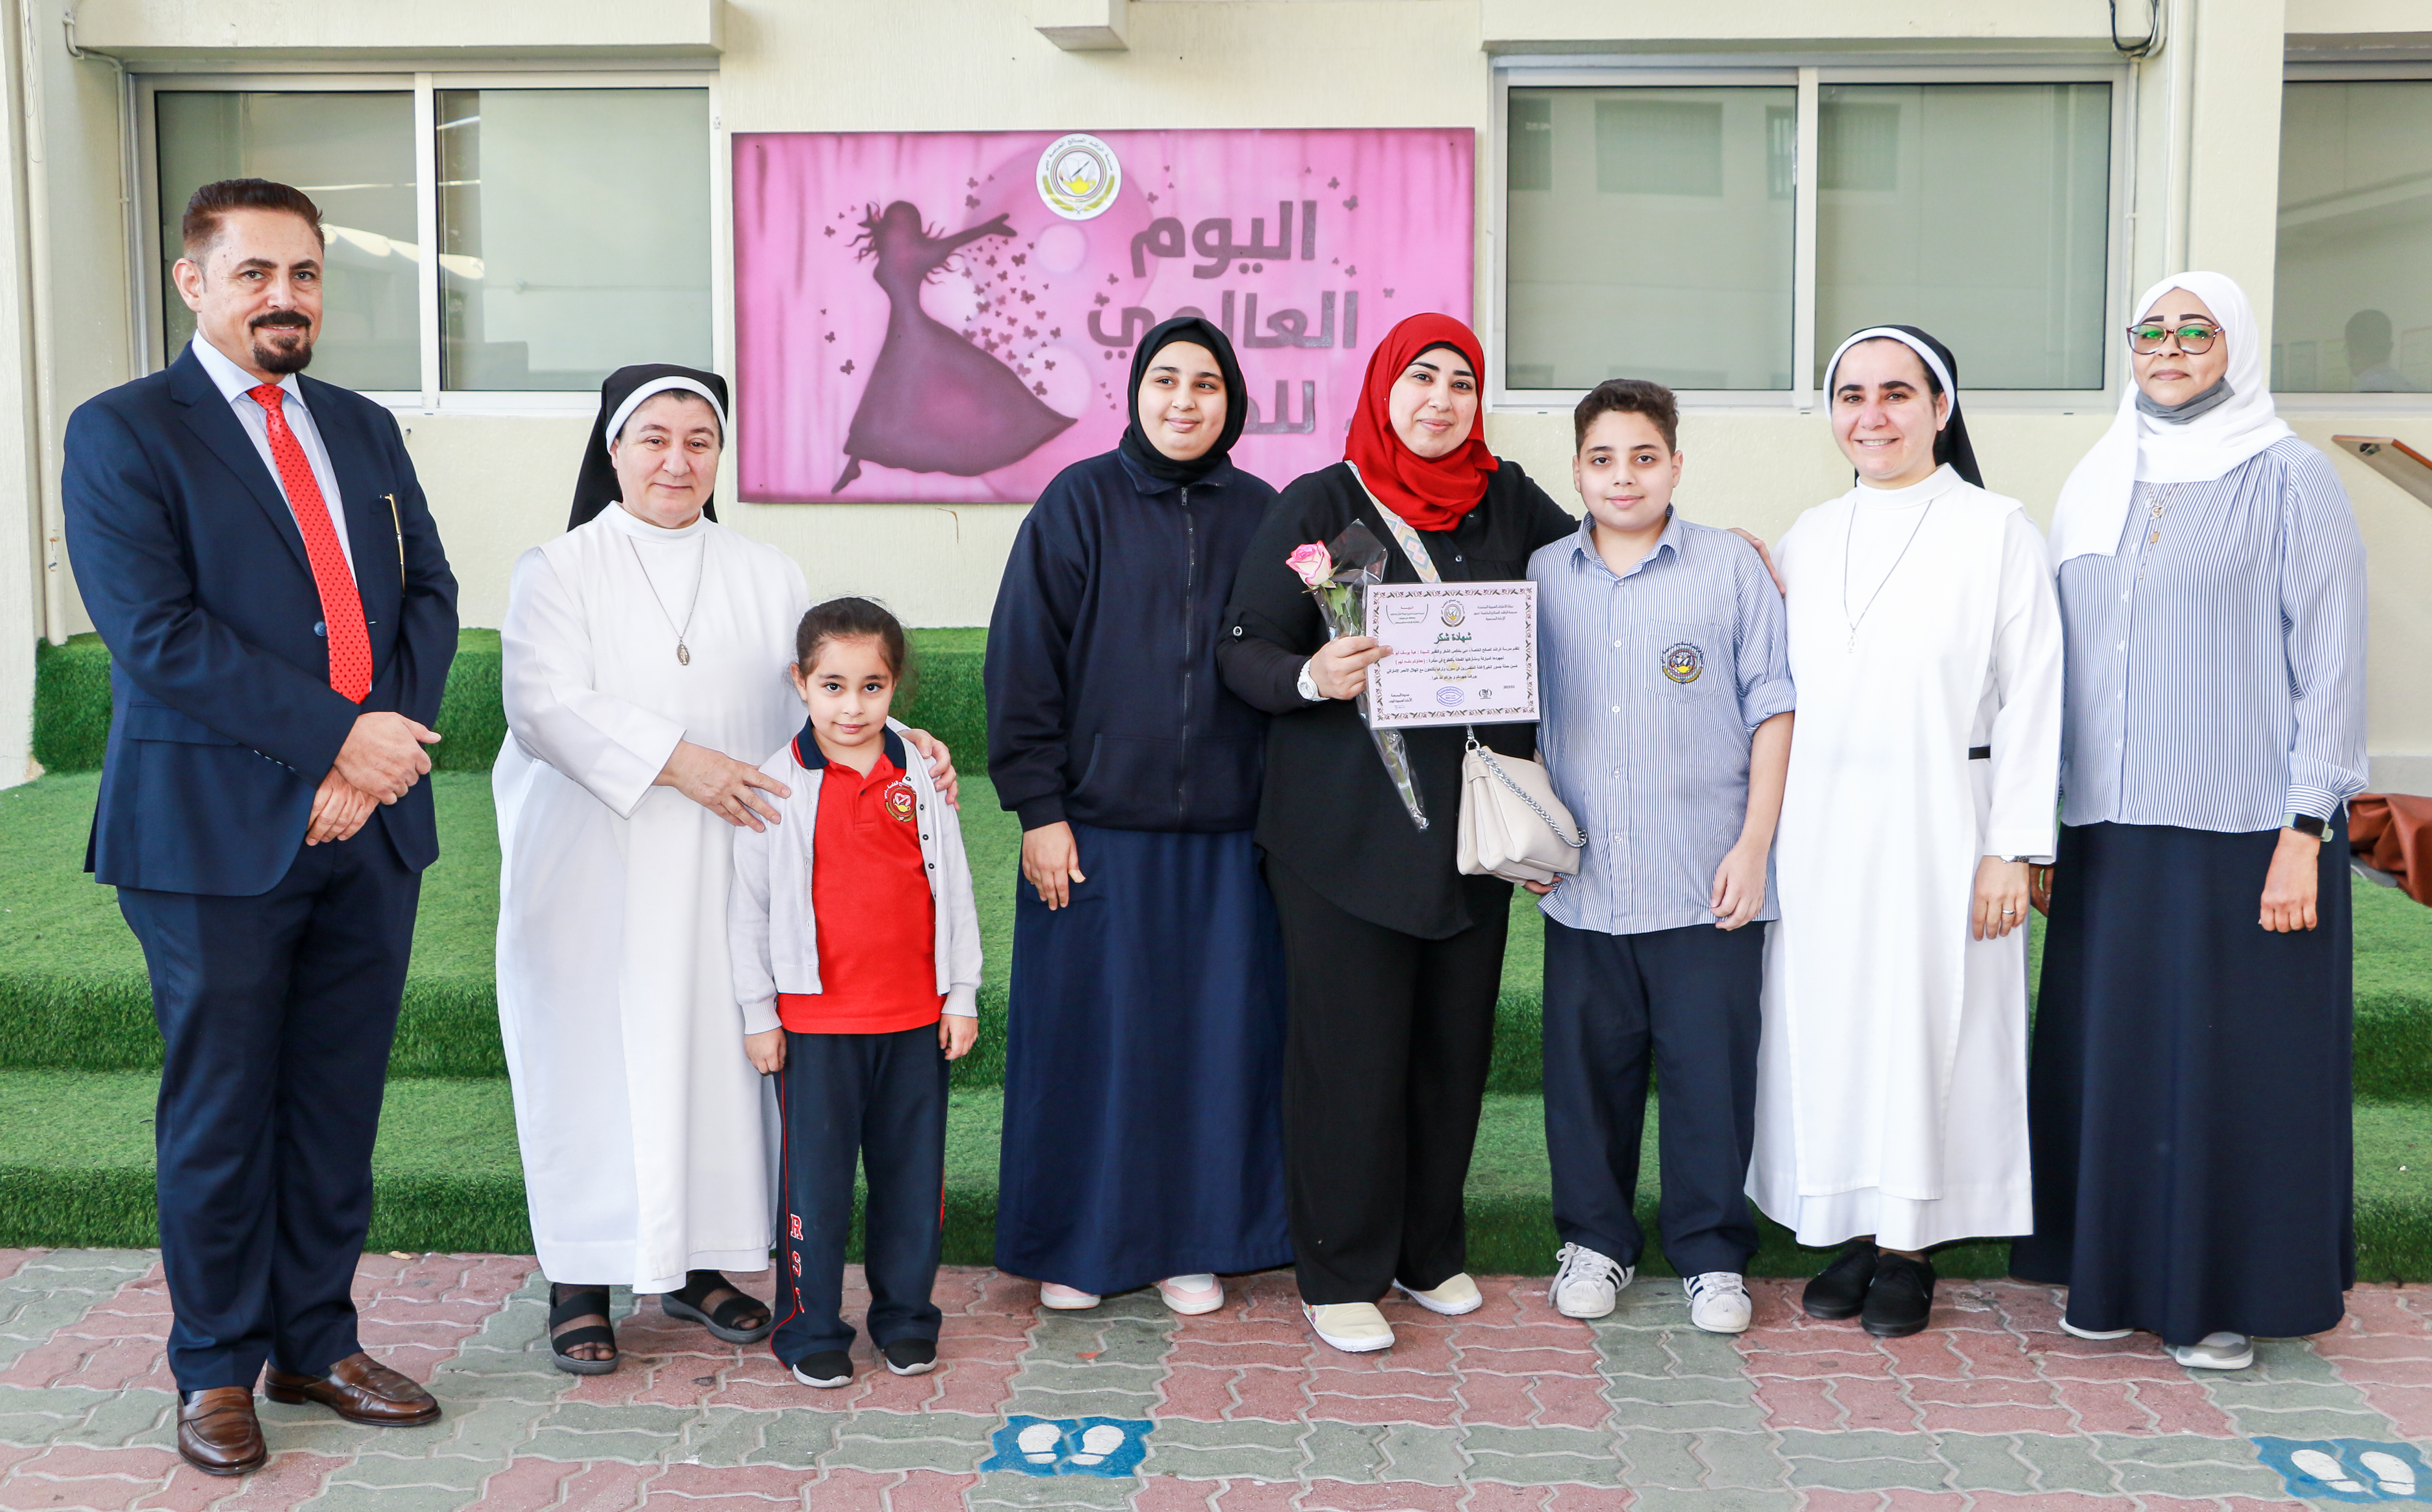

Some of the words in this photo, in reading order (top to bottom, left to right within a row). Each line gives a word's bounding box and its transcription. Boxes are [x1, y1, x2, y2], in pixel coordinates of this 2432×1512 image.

[1047, 141, 1065, 158] الخاصة
[1089, 141, 1104, 152] الراشد
[1131, 200, 1317, 279] اليوم
[1087, 290, 1359, 360] العالي
[1434, 632, 1449, 644] شكر
[1452, 632, 1472, 643] شهادة
